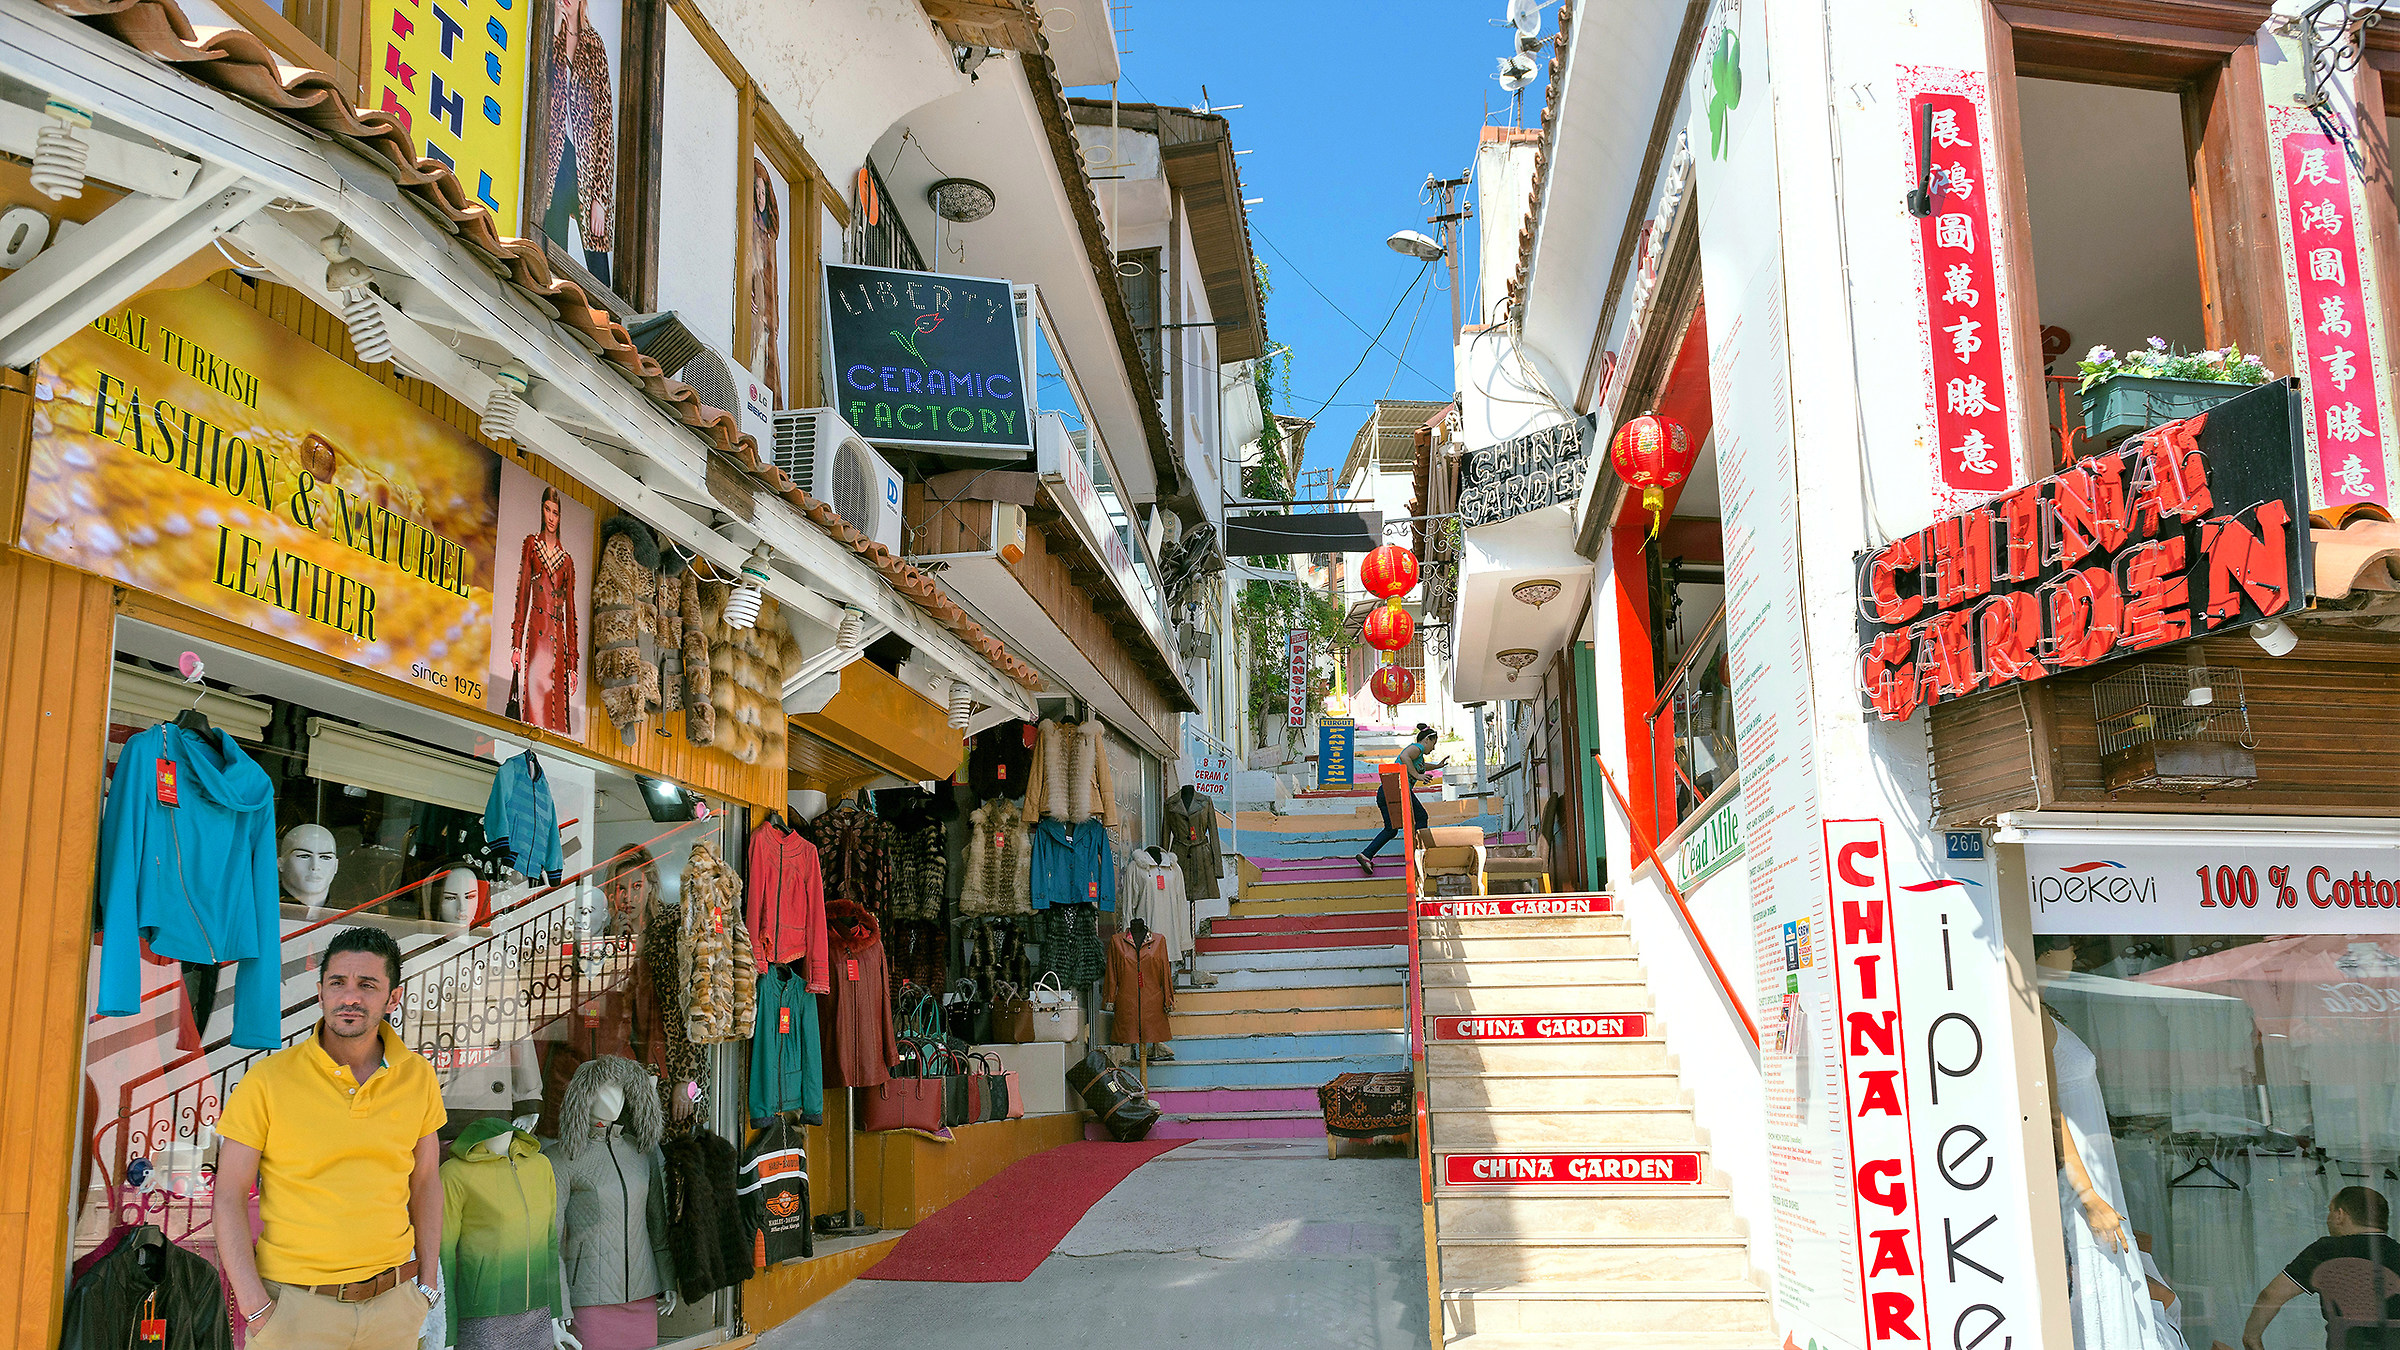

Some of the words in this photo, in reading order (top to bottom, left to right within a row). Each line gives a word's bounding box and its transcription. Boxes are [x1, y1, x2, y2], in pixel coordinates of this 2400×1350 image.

[838, 279, 1004, 324] LIBERTY
[2294, 148, 2376, 498] 展鴻圖萬事勝意
[160, 326, 260, 410] TURKISH
[846, 364, 1014, 400] CERAMIC
[747, 401, 768, 423] BEKO
[759, 393, 768, 407] LG
[850, 400, 1018, 435] FACTORY
[1470, 419, 1581, 484] CHINA
[90, 368, 279, 514] FASHION
[290, 470, 318, 533] &
[332, 486, 471, 599] NATUREL
[1859, 412, 2214, 625] CHINA
[213, 523, 377, 643] LEATHER
[1853, 499, 2291, 723] GARDEN
[411, 662, 449, 689] since
[454, 674, 483, 701] 1975
[1682, 835, 1708, 880] Céad
[1710, 805, 1739, 860] Mile
[1439, 900, 1499, 916] CHINA
[1511, 899, 1591, 915] GARDEN
[2196, 864, 2260, 909] 100
[2267, 864, 2299, 909] %
[1837, 840, 1902, 1118] CHINA
[1457, 1019, 1524, 1038] CHINA
[1536, 1017, 1625, 1037] GARDEN
[1473, 1159, 1554, 1179] CHINA
[1569, 1158, 1675, 1180] GARDEN
[1857, 1158, 1921, 1341] GAR
